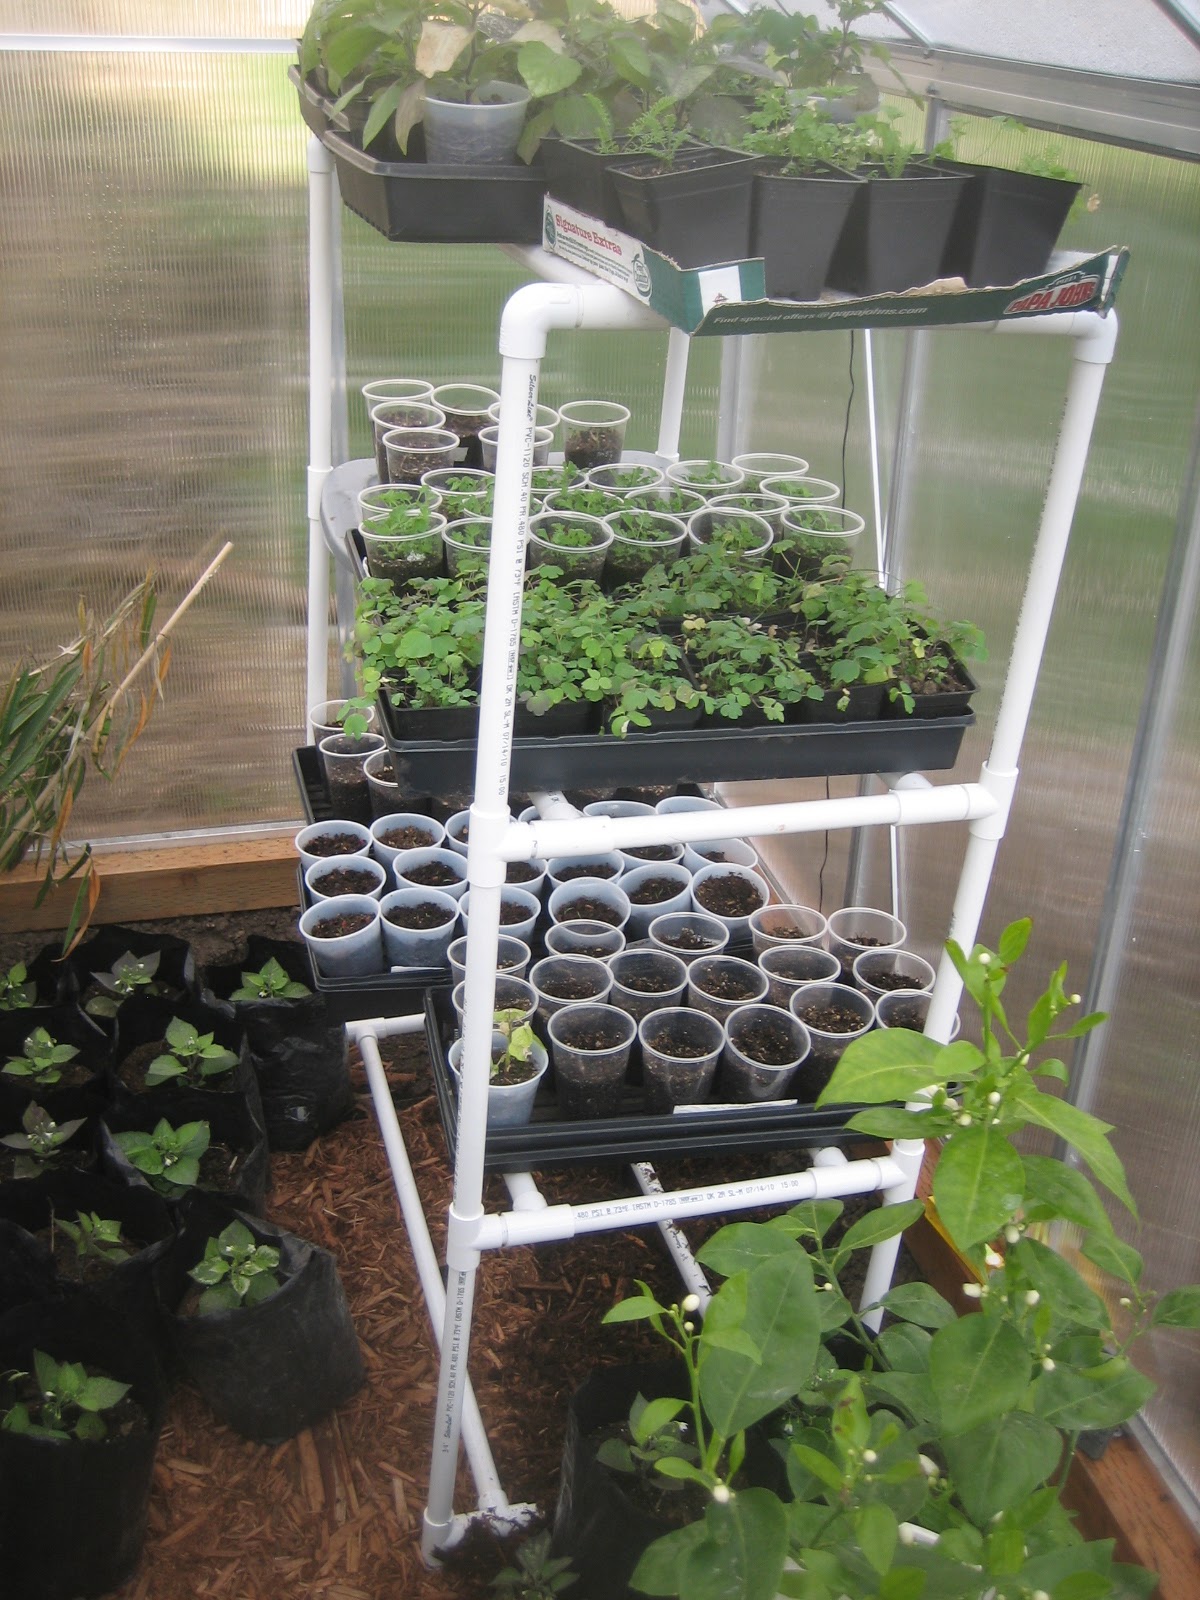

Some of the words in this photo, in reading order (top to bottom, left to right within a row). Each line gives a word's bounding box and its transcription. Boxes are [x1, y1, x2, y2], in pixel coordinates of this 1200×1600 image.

[555, 213, 592, 241] Signature
[591, 231, 622, 256] Extras
[713, 315, 739, 324] Find
[738, 313, 782, 323] special
[782, 311, 814, 320] offers
[827, 303, 928, 321] papajohns.com
[1008, 290, 1053, 312] PAPA
[522, 426, 532, 467] PVC-1120
[520, 471, 529, 502] SCH.40
[517, 505, 526, 535] PR.480
[516, 539, 524, 553] PSI
[500, 731, 509, 766] 07/14/10
[745, 1182, 774, 1194] 07/14/10
